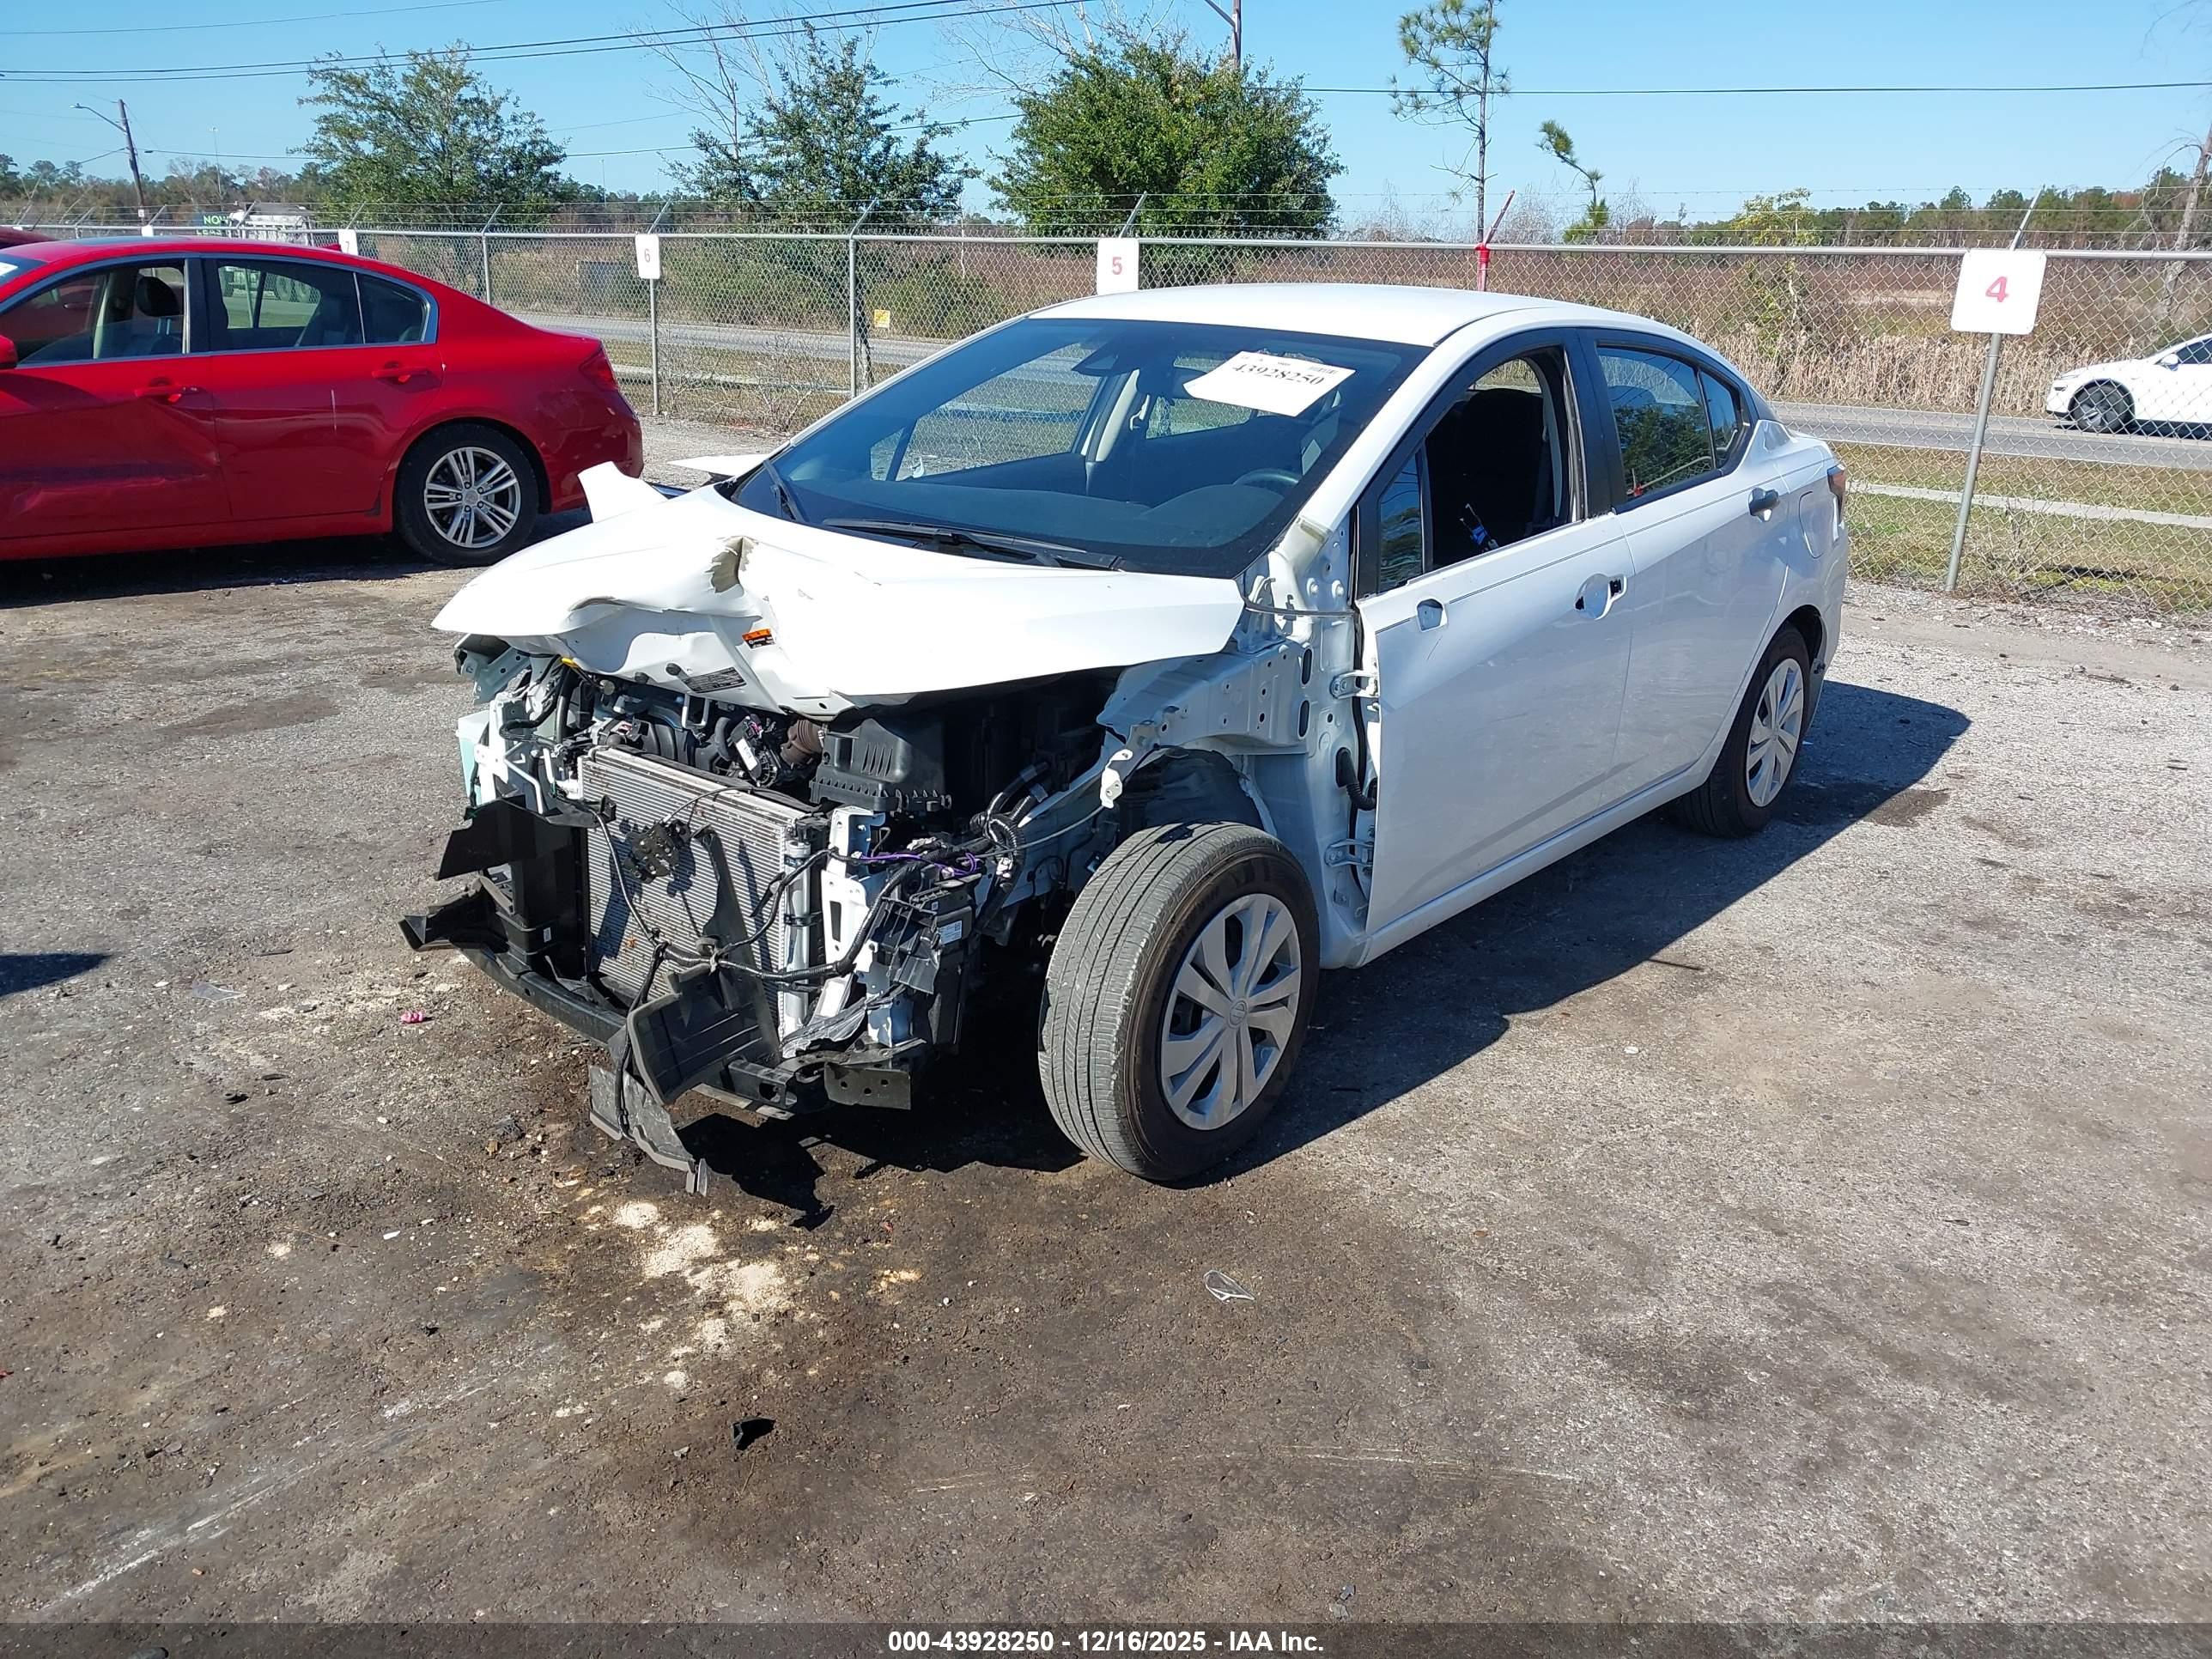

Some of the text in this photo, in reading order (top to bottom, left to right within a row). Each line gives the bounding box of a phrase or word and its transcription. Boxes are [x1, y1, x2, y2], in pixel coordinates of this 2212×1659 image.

[644, 248, 651, 263] 6
[1112, 256, 1123, 276] 5
[1985, 276, 2009, 303] 4
[1232, 363, 1325, 385] 43928250
